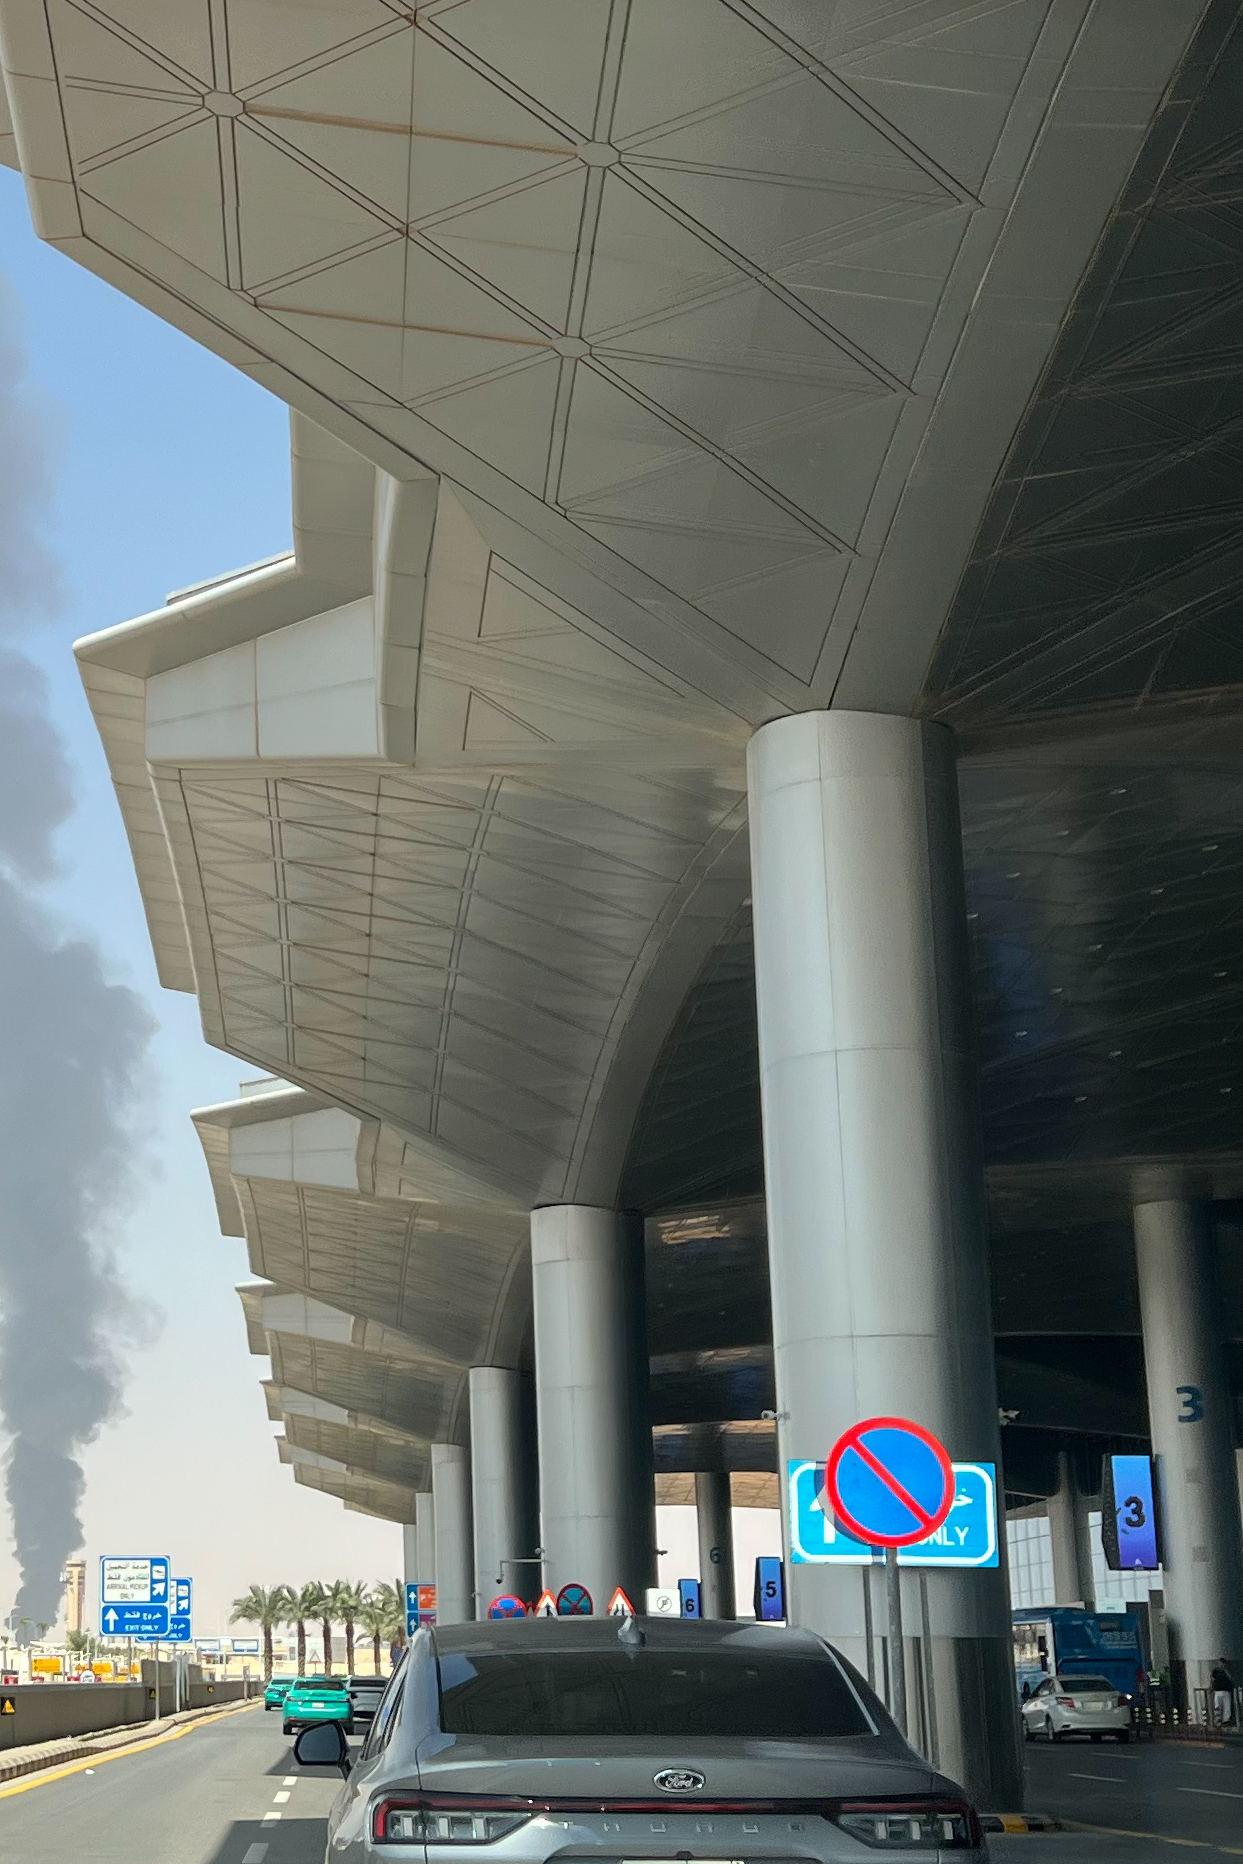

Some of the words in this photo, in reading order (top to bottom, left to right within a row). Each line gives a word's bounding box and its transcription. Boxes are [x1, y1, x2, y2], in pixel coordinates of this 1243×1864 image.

[1176, 1385, 1204, 1423] 3
[1124, 1495, 1146, 1528] 3
[917, 1526, 970, 1546] NLY
[765, 1580, 777, 1598] 5
[685, 1598, 695, 1613] 6
[140, 1624, 160, 1632] ONLY
